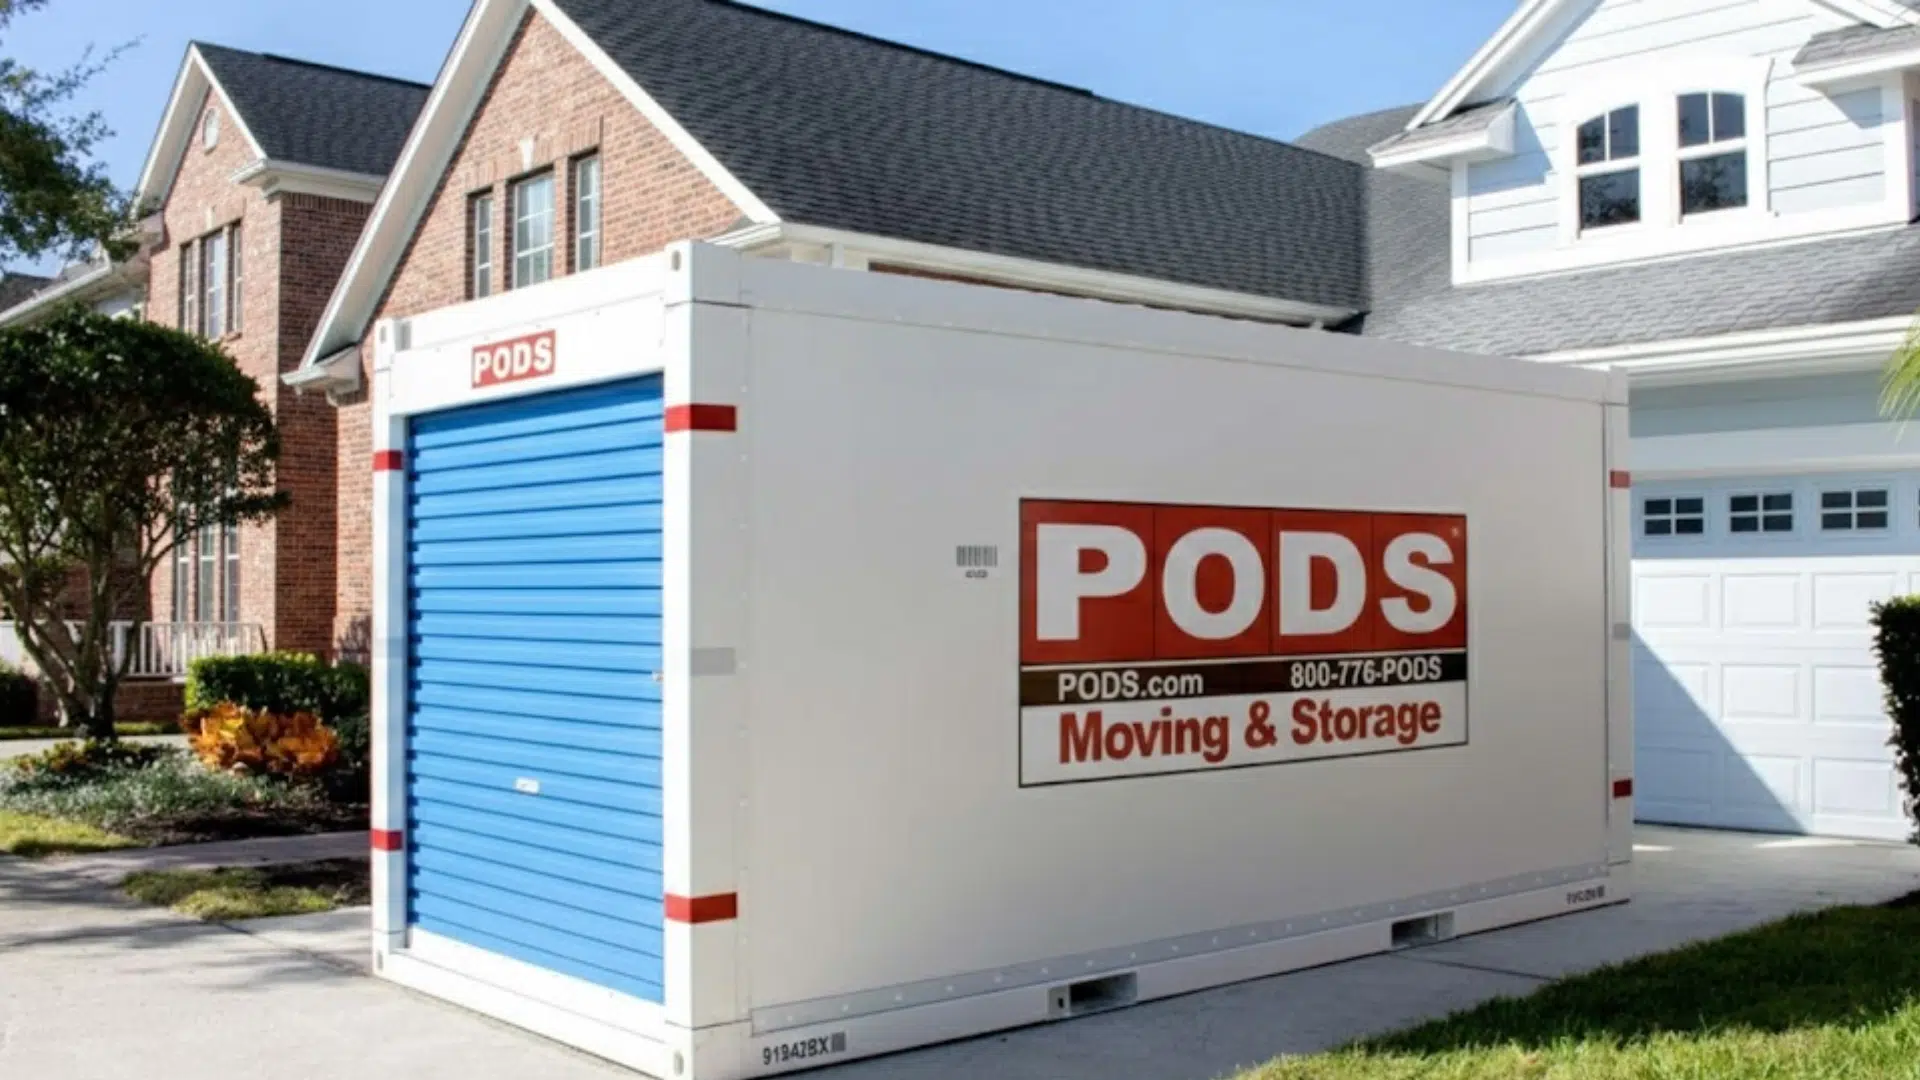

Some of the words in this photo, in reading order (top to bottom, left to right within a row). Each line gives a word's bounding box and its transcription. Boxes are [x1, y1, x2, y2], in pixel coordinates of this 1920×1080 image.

[474, 337, 552, 384] PODS
[1036, 522, 1457, 640] PODS
[1058, 670, 1203, 702] PODS.com
[1290, 655, 1442, 688] 800-776-PODS
[1060, 706, 1229, 764] Moving
[1244, 700, 1277, 748] &
[1291, 698, 1441, 745] Storage
